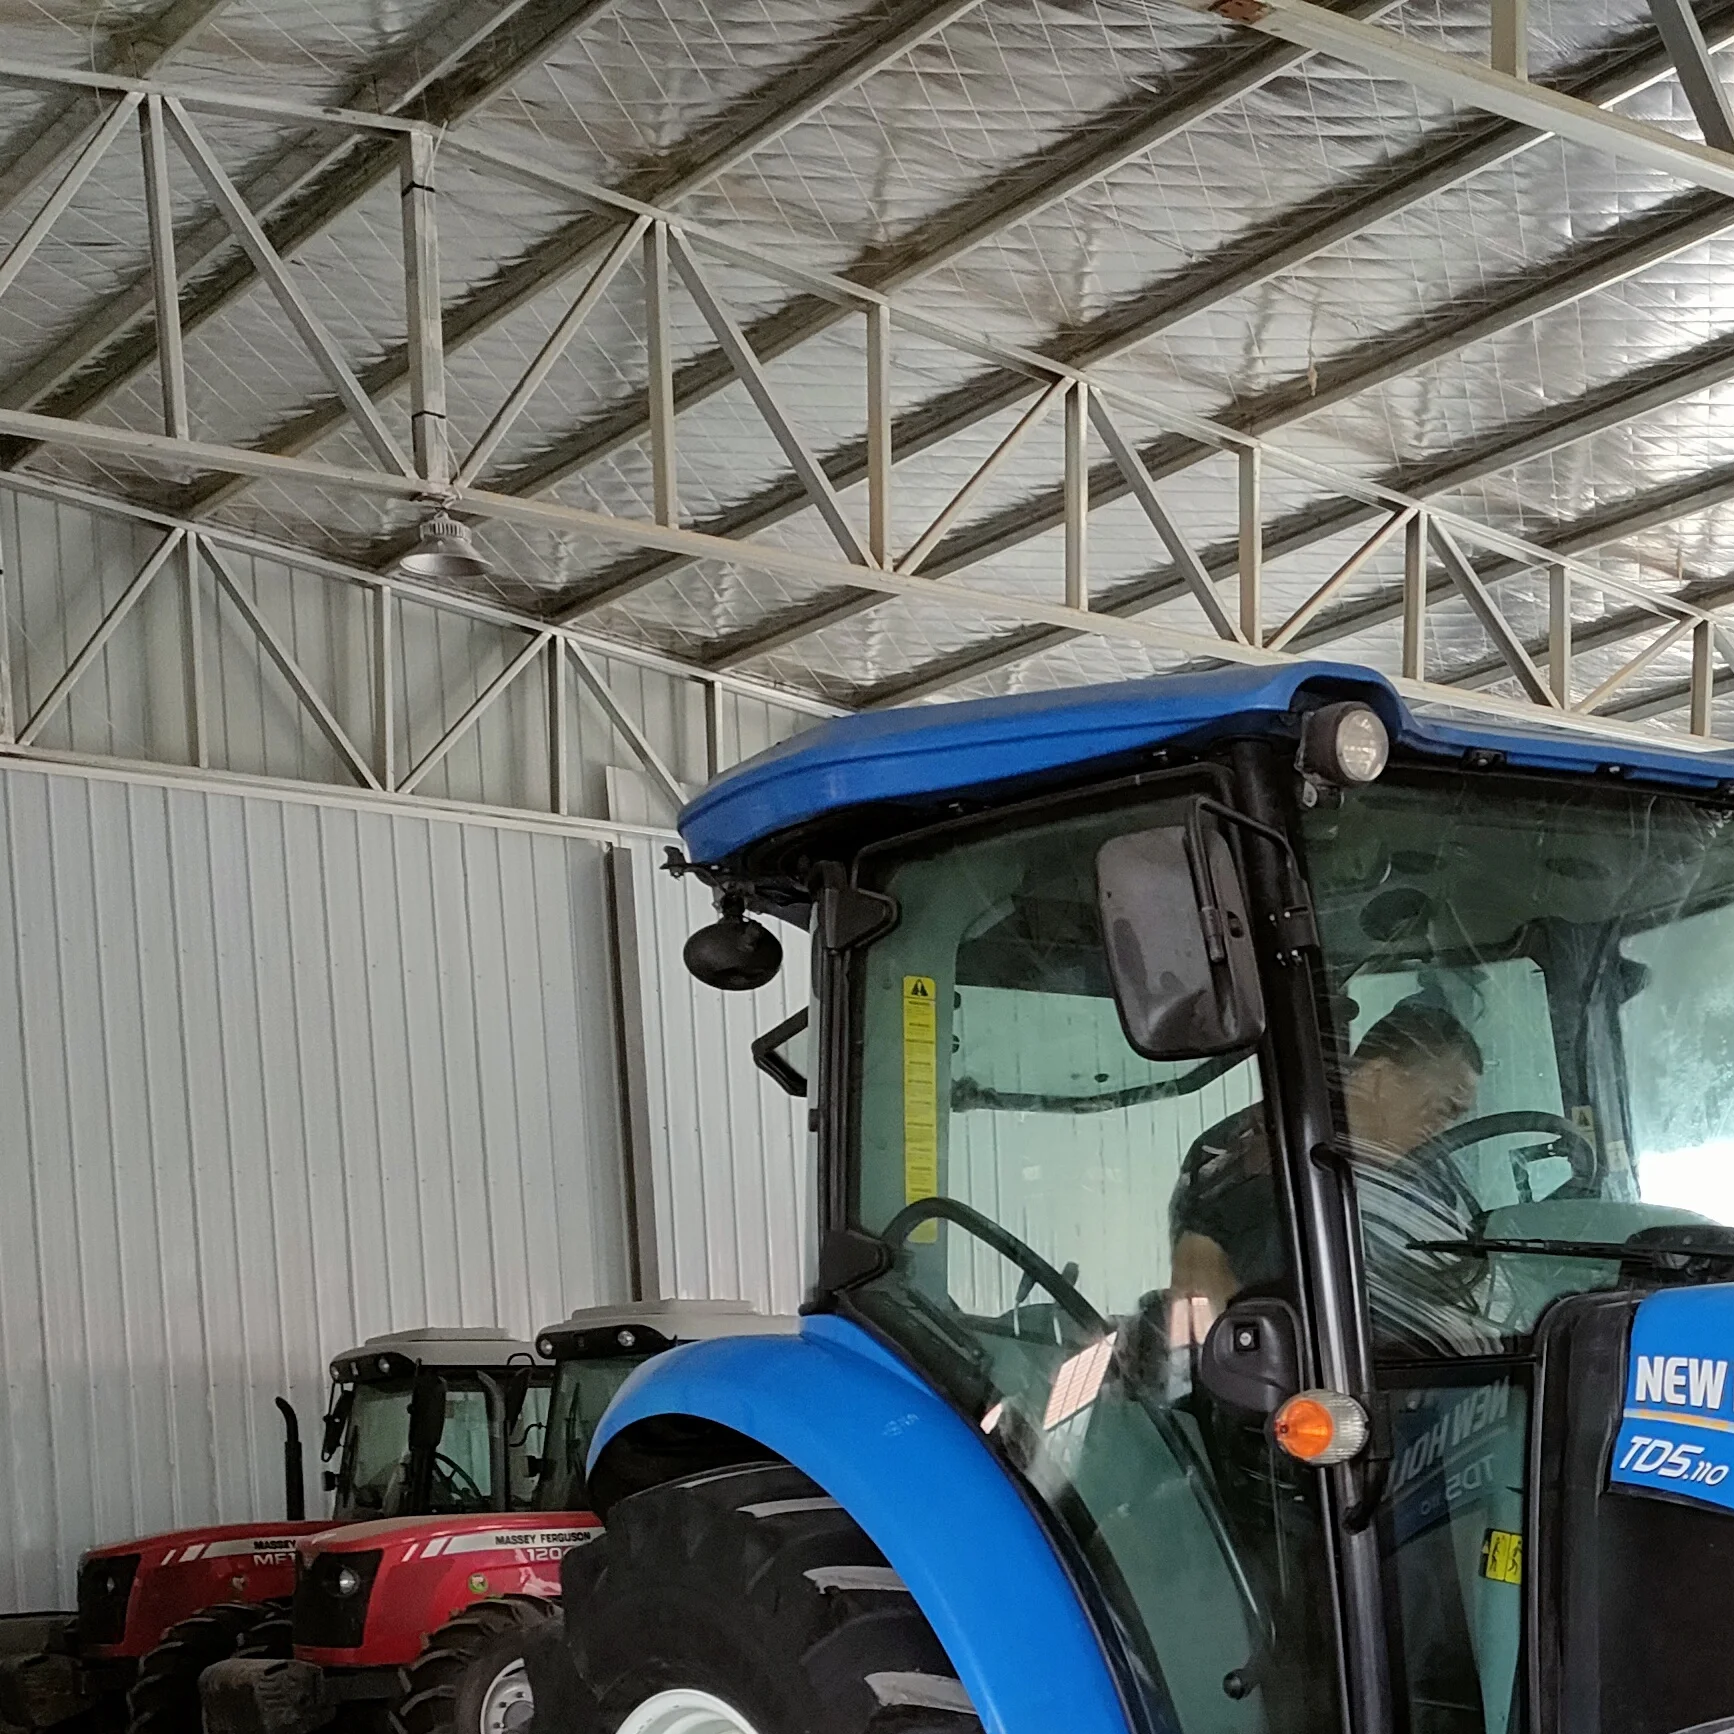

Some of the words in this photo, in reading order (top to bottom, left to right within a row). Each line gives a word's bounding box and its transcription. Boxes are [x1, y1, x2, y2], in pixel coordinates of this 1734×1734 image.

[1635, 1355, 1728, 1410] NEW
[1619, 1435, 1730, 1486] TD5.110
[253, 1540, 297, 1550] MASSEY
[494, 1534, 537, 1545] MASSEY
[540, 1531, 591, 1543] FERGUSON
